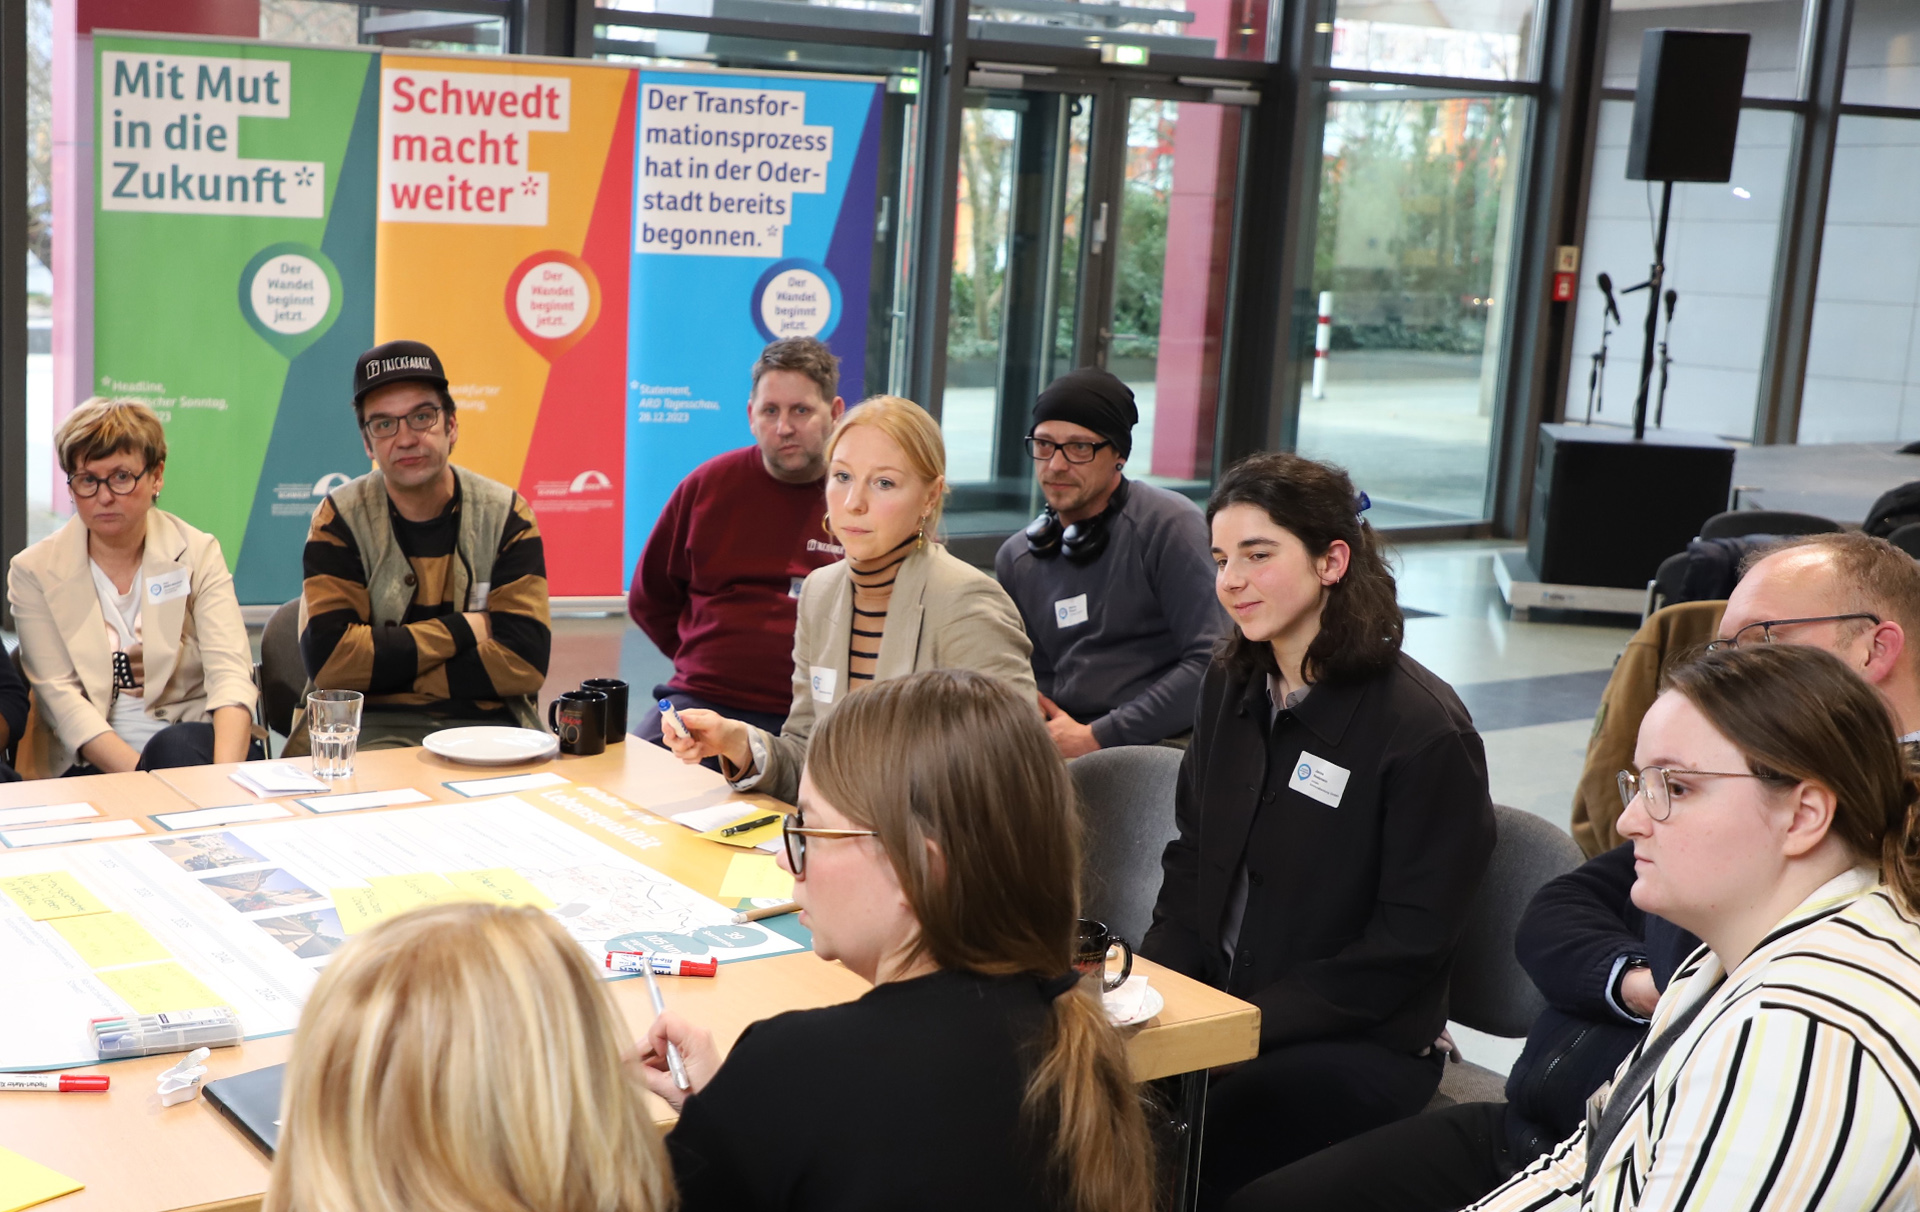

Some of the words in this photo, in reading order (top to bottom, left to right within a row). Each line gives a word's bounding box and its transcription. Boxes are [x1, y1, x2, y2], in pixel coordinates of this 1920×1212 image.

[114, 60, 184, 100] Mit
[196, 65, 280, 105] Mut
[392, 76, 560, 120] Schwedt
[648, 89, 688, 111] Der
[693, 90, 799, 116] Transfor-
[114, 109, 151, 148] in
[164, 112, 227, 151] die
[646, 124, 827, 153] mationsprozess
[393, 130, 518, 166] macht
[645, 156, 683, 178] hat
[688, 157, 708, 179] in
[715, 159, 751, 181] der
[757, 160, 820, 183] Oder-
[643, 191, 703, 212] stadt
[709, 192, 786, 215] bereits
[643, 222, 762, 250] begonnen.
[280, 262, 302, 275] Der
[543, 269, 563, 281] Der
[267, 278, 314, 290] Wandel
[787, 276, 806, 288] Der
[531, 285, 574, 296] Wandel
[776, 291, 816, 302] Wandel
[267, 294, 314, 308] beginnt
[531, 299, 574, 313] beginnt
[273, 309, 307, 324] jetzt.
[775, 306, 816, 318] beginnt
[780, 319, 808, 332] jetzt.
[640, 383, 692, 397] Statement,
[540, 789, 662, 849] Lebensqualität
